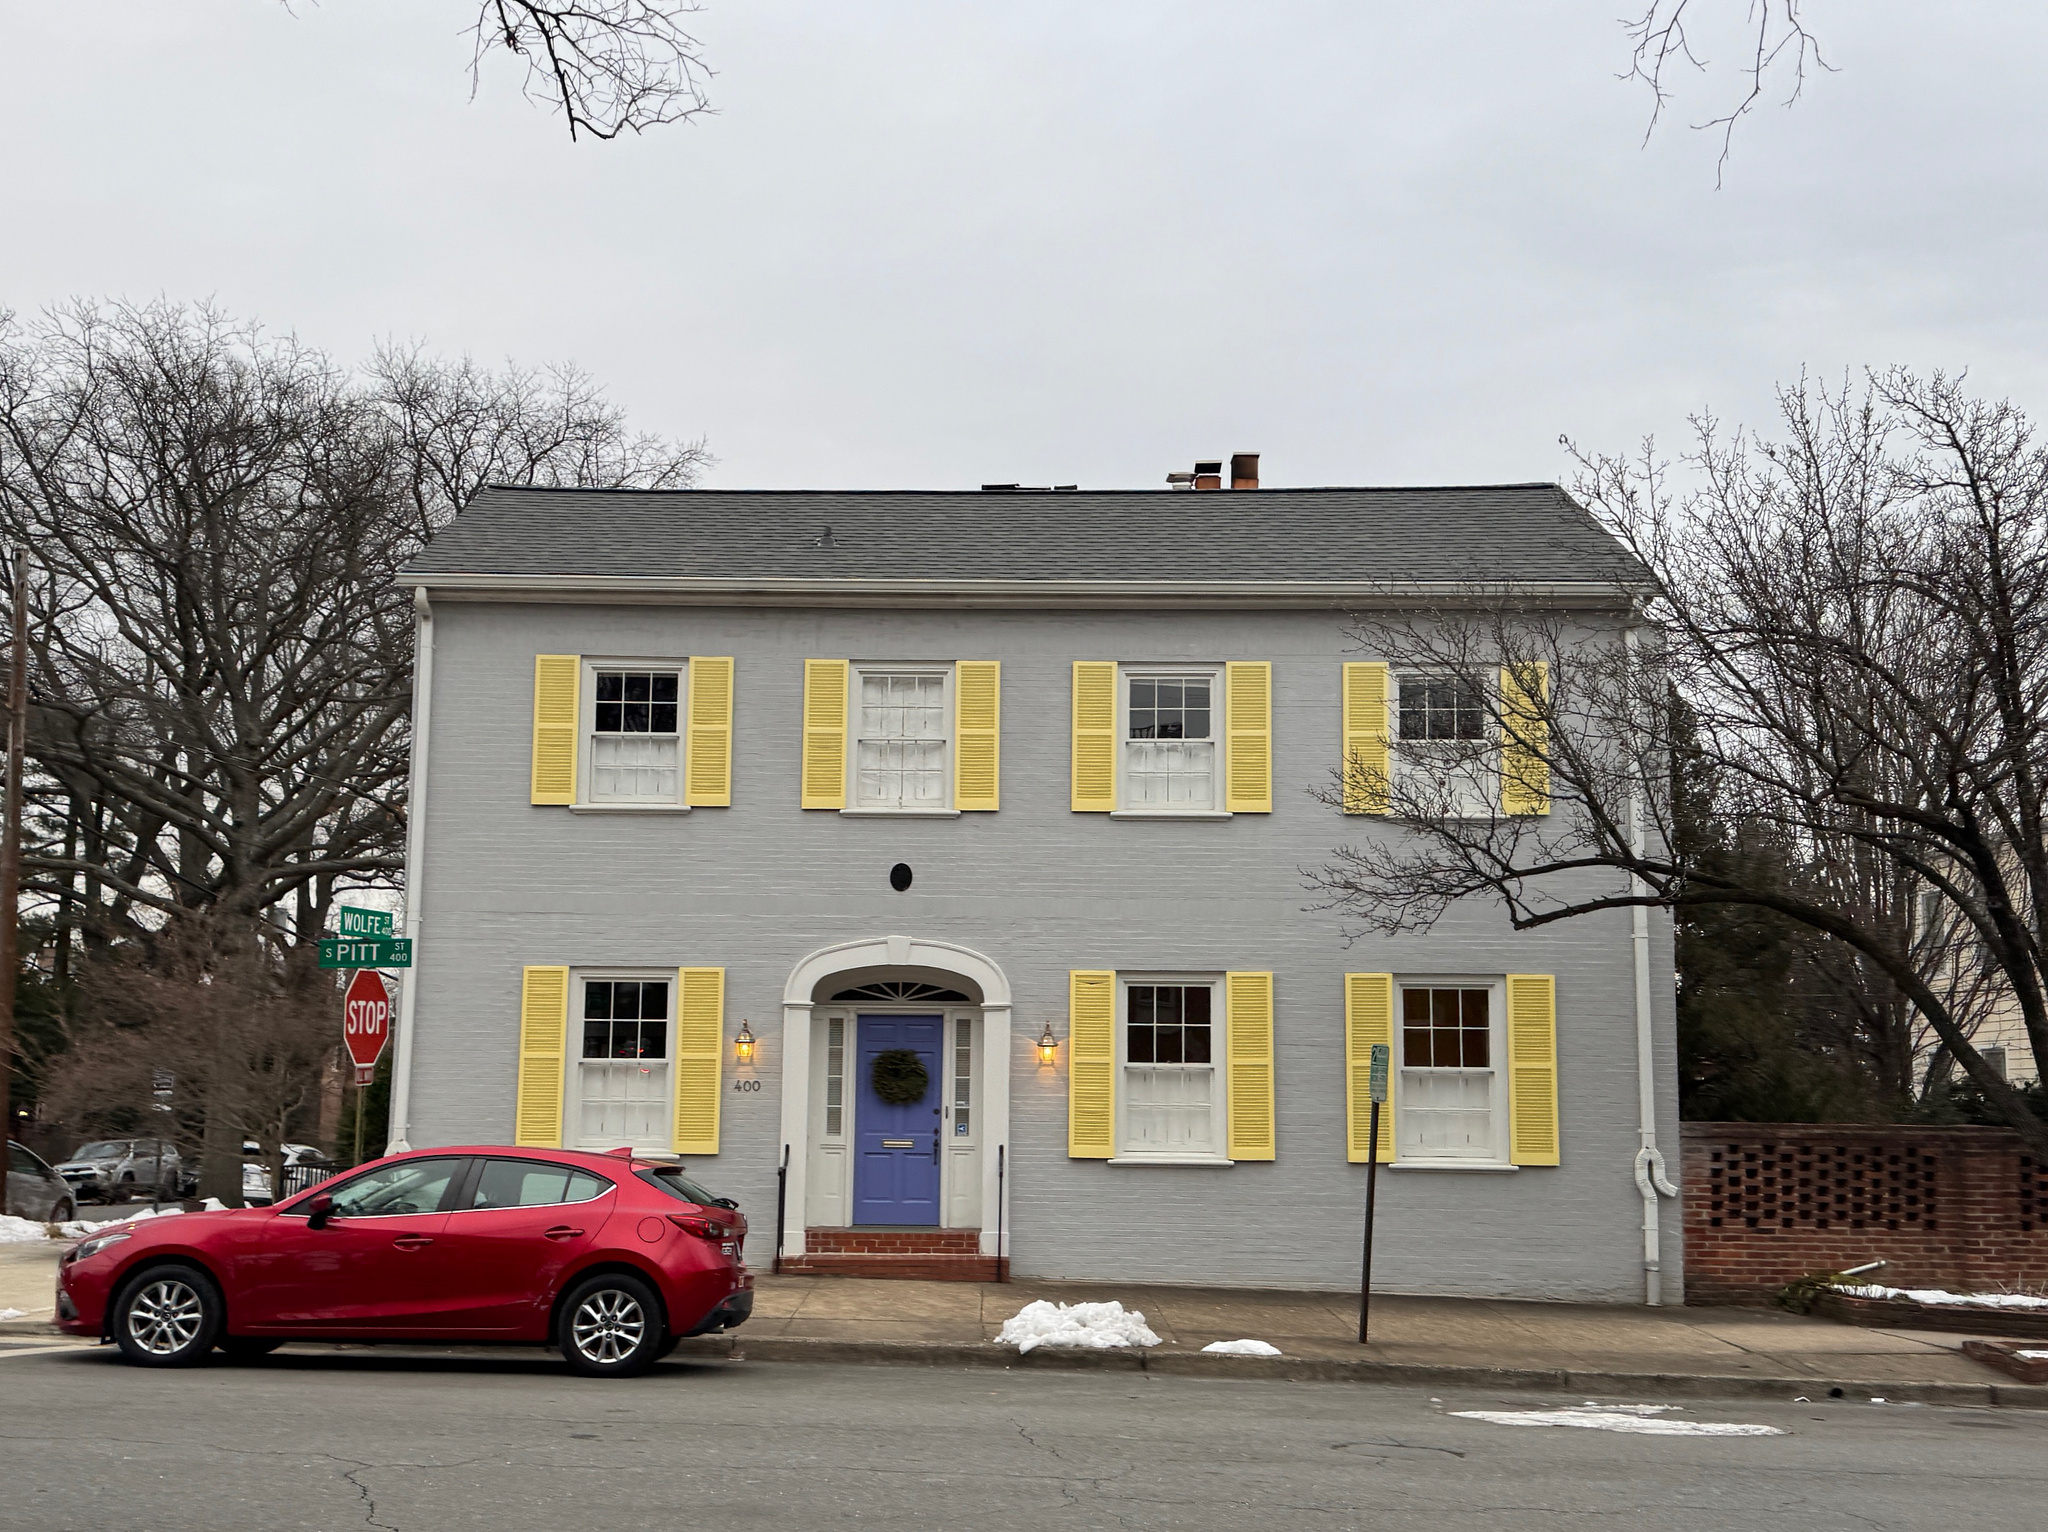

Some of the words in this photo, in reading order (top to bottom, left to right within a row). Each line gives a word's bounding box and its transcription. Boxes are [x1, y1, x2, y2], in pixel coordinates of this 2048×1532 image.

[344, 912, 381, 935] WOLFE
[384, 916, 390, 925] ST
[381, 927, 392, 936] 400
[326, 948, 332, 958] S
[337, 943, 380, 962] PITT
[394, 942, 405, 951] ST
[389, 953, 408, 962] 400
[347, 1000, 387, 1035] STOP
[734, 1079, 761, 1092] 400
